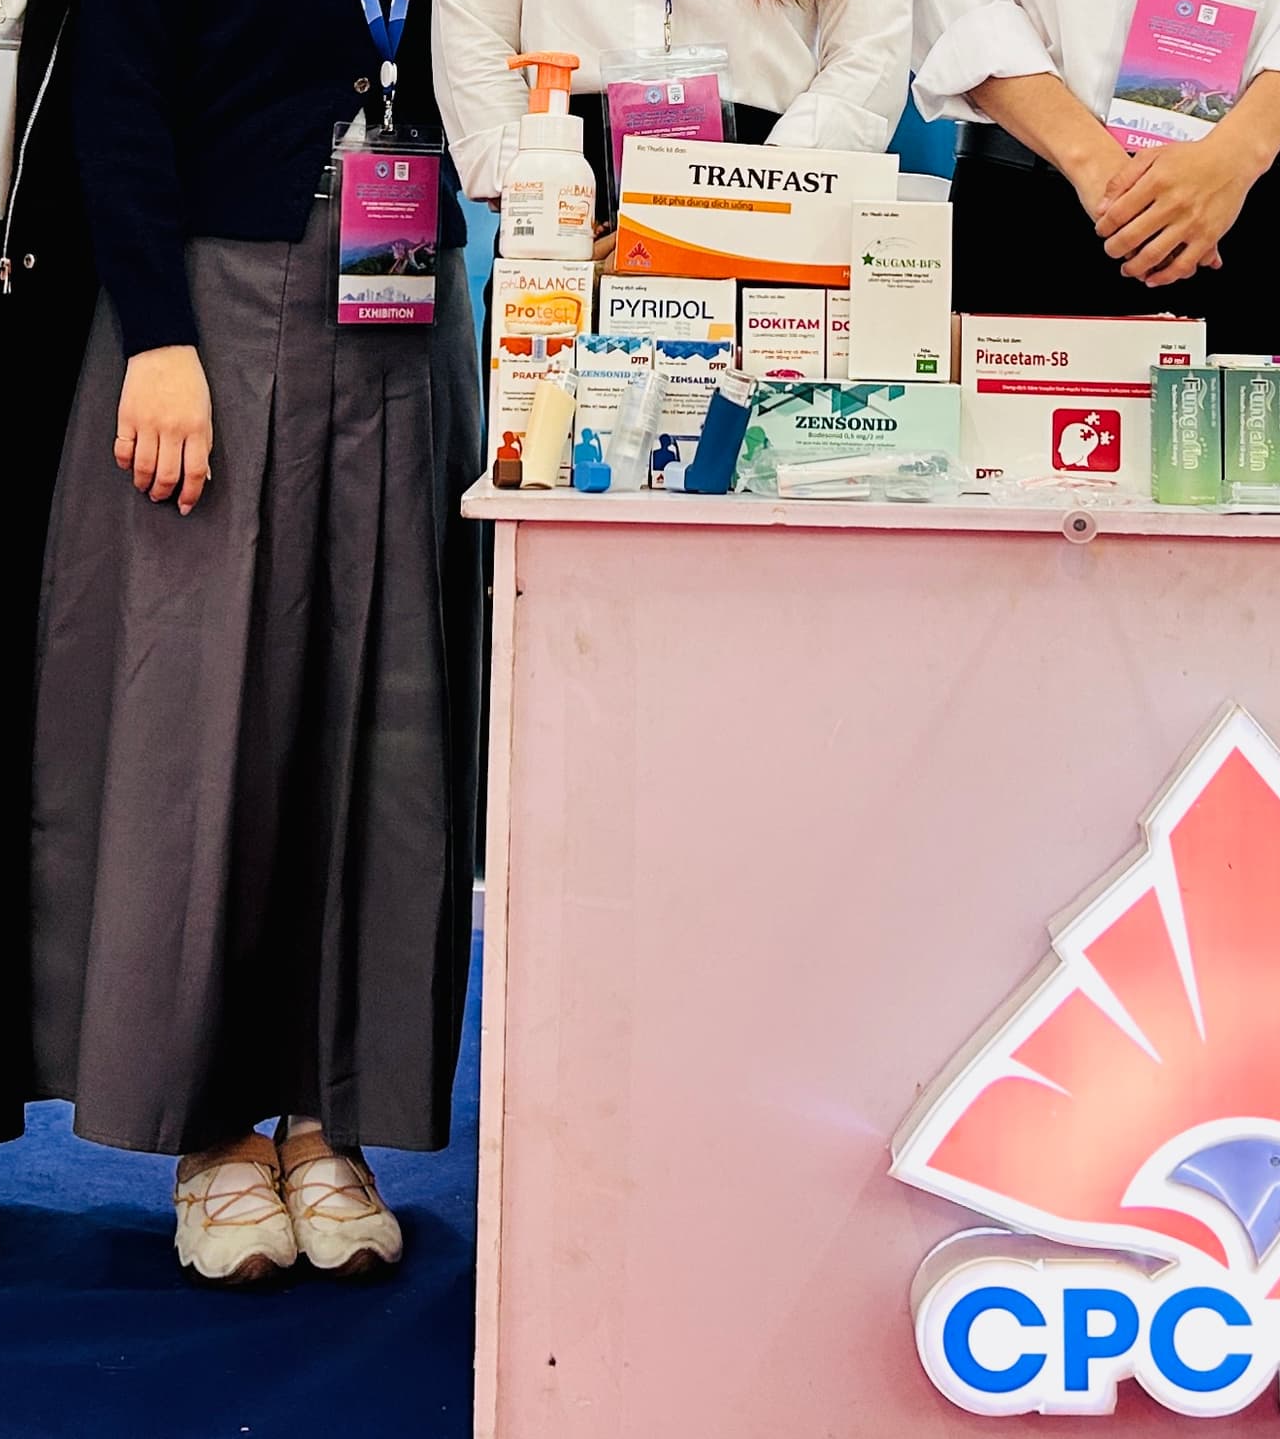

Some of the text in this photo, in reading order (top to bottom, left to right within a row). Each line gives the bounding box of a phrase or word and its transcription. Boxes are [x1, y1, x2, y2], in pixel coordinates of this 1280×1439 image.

[688, 164, 839, 194] TRANFAST
[669, 197, 686, 208] pha
[687, 197, 710, 210] dung
[875, 258, 942, 270] SUGAM-BFS
[358, 307, 414, 320] EXHIBITION
[610, 298, 715, 320] PYRIDOL
[748, 317, 821, 331] DOKITAM
[631, 356, 649, 366] DTP
[976, 348, 1069, 368] Piracetam-SB
[708, 361, 728, 372] DTP
[795, 415, 898, 432] ZENSONID
